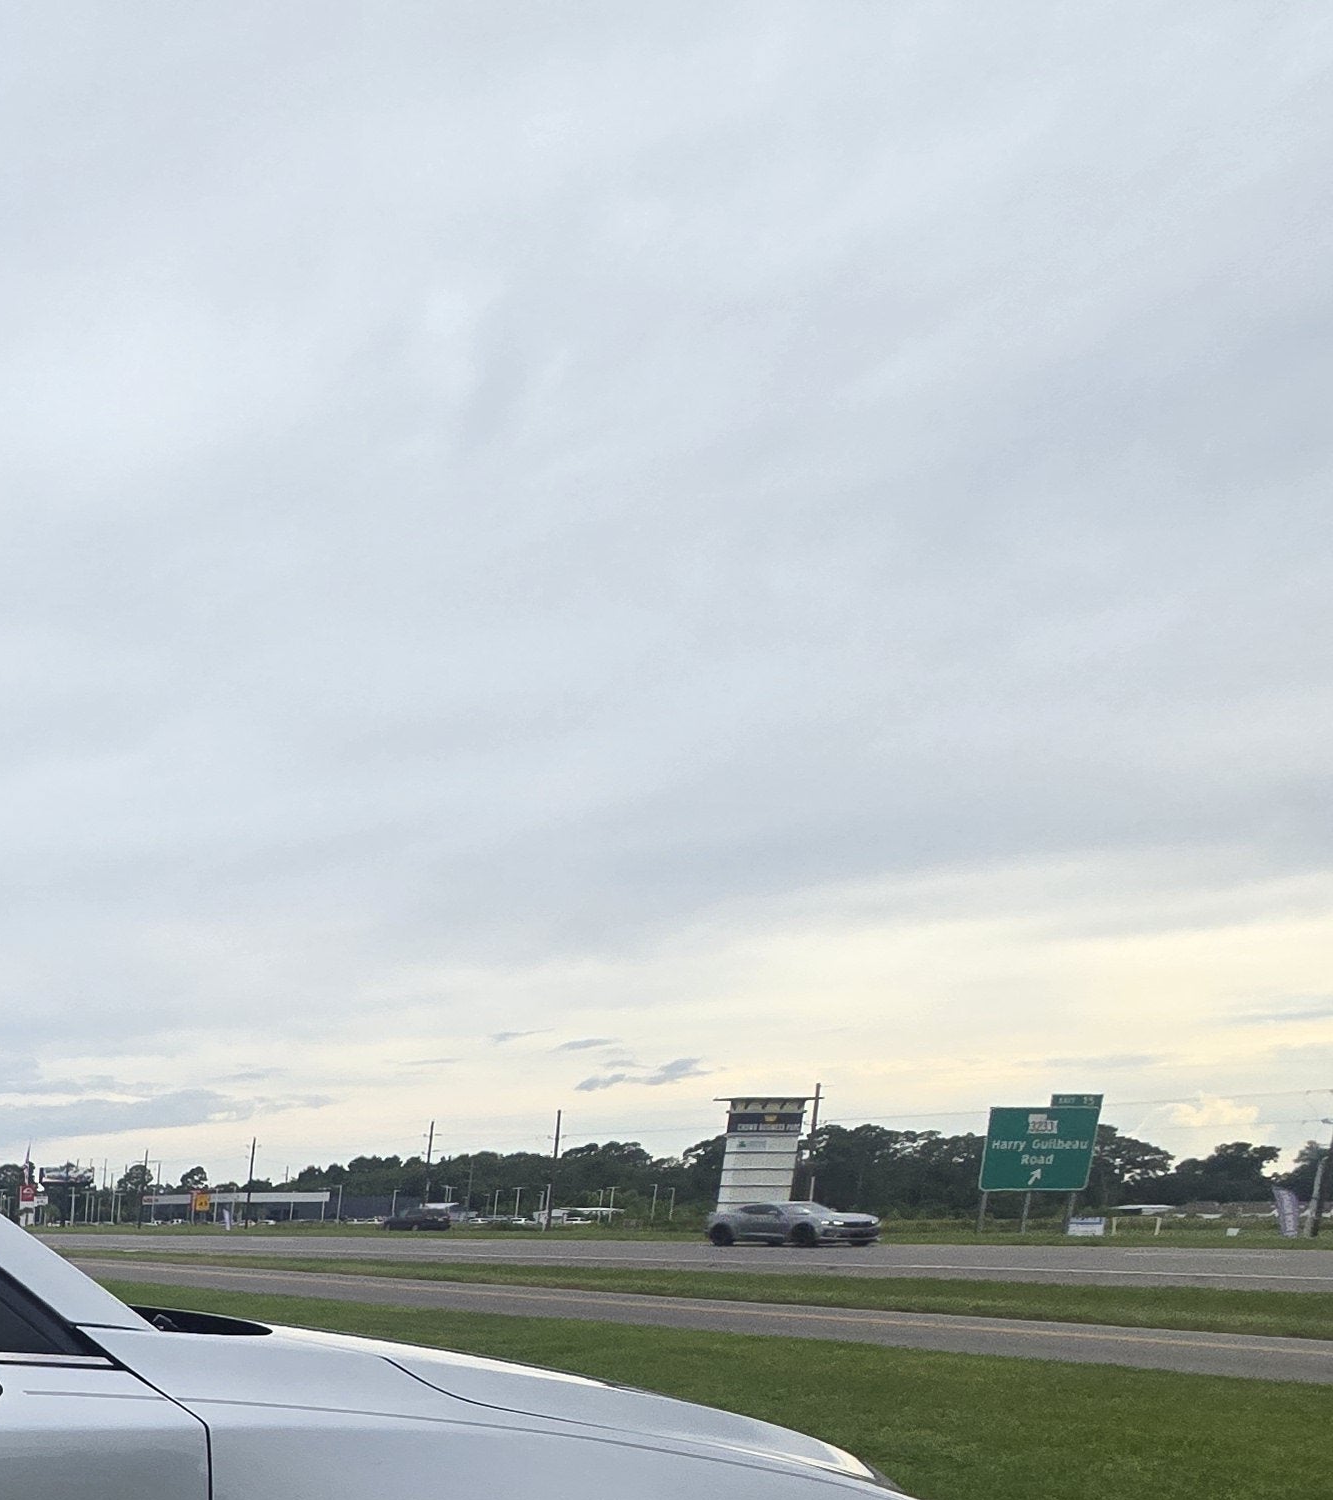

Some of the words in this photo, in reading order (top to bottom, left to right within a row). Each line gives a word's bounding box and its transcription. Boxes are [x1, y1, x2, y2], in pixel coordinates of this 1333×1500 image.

[991, 1139, 1027, 1152] Harry
[1031, 1138, 1089, 1150] Guilbeau
[1020, 1154, 1055, 1165] Road
